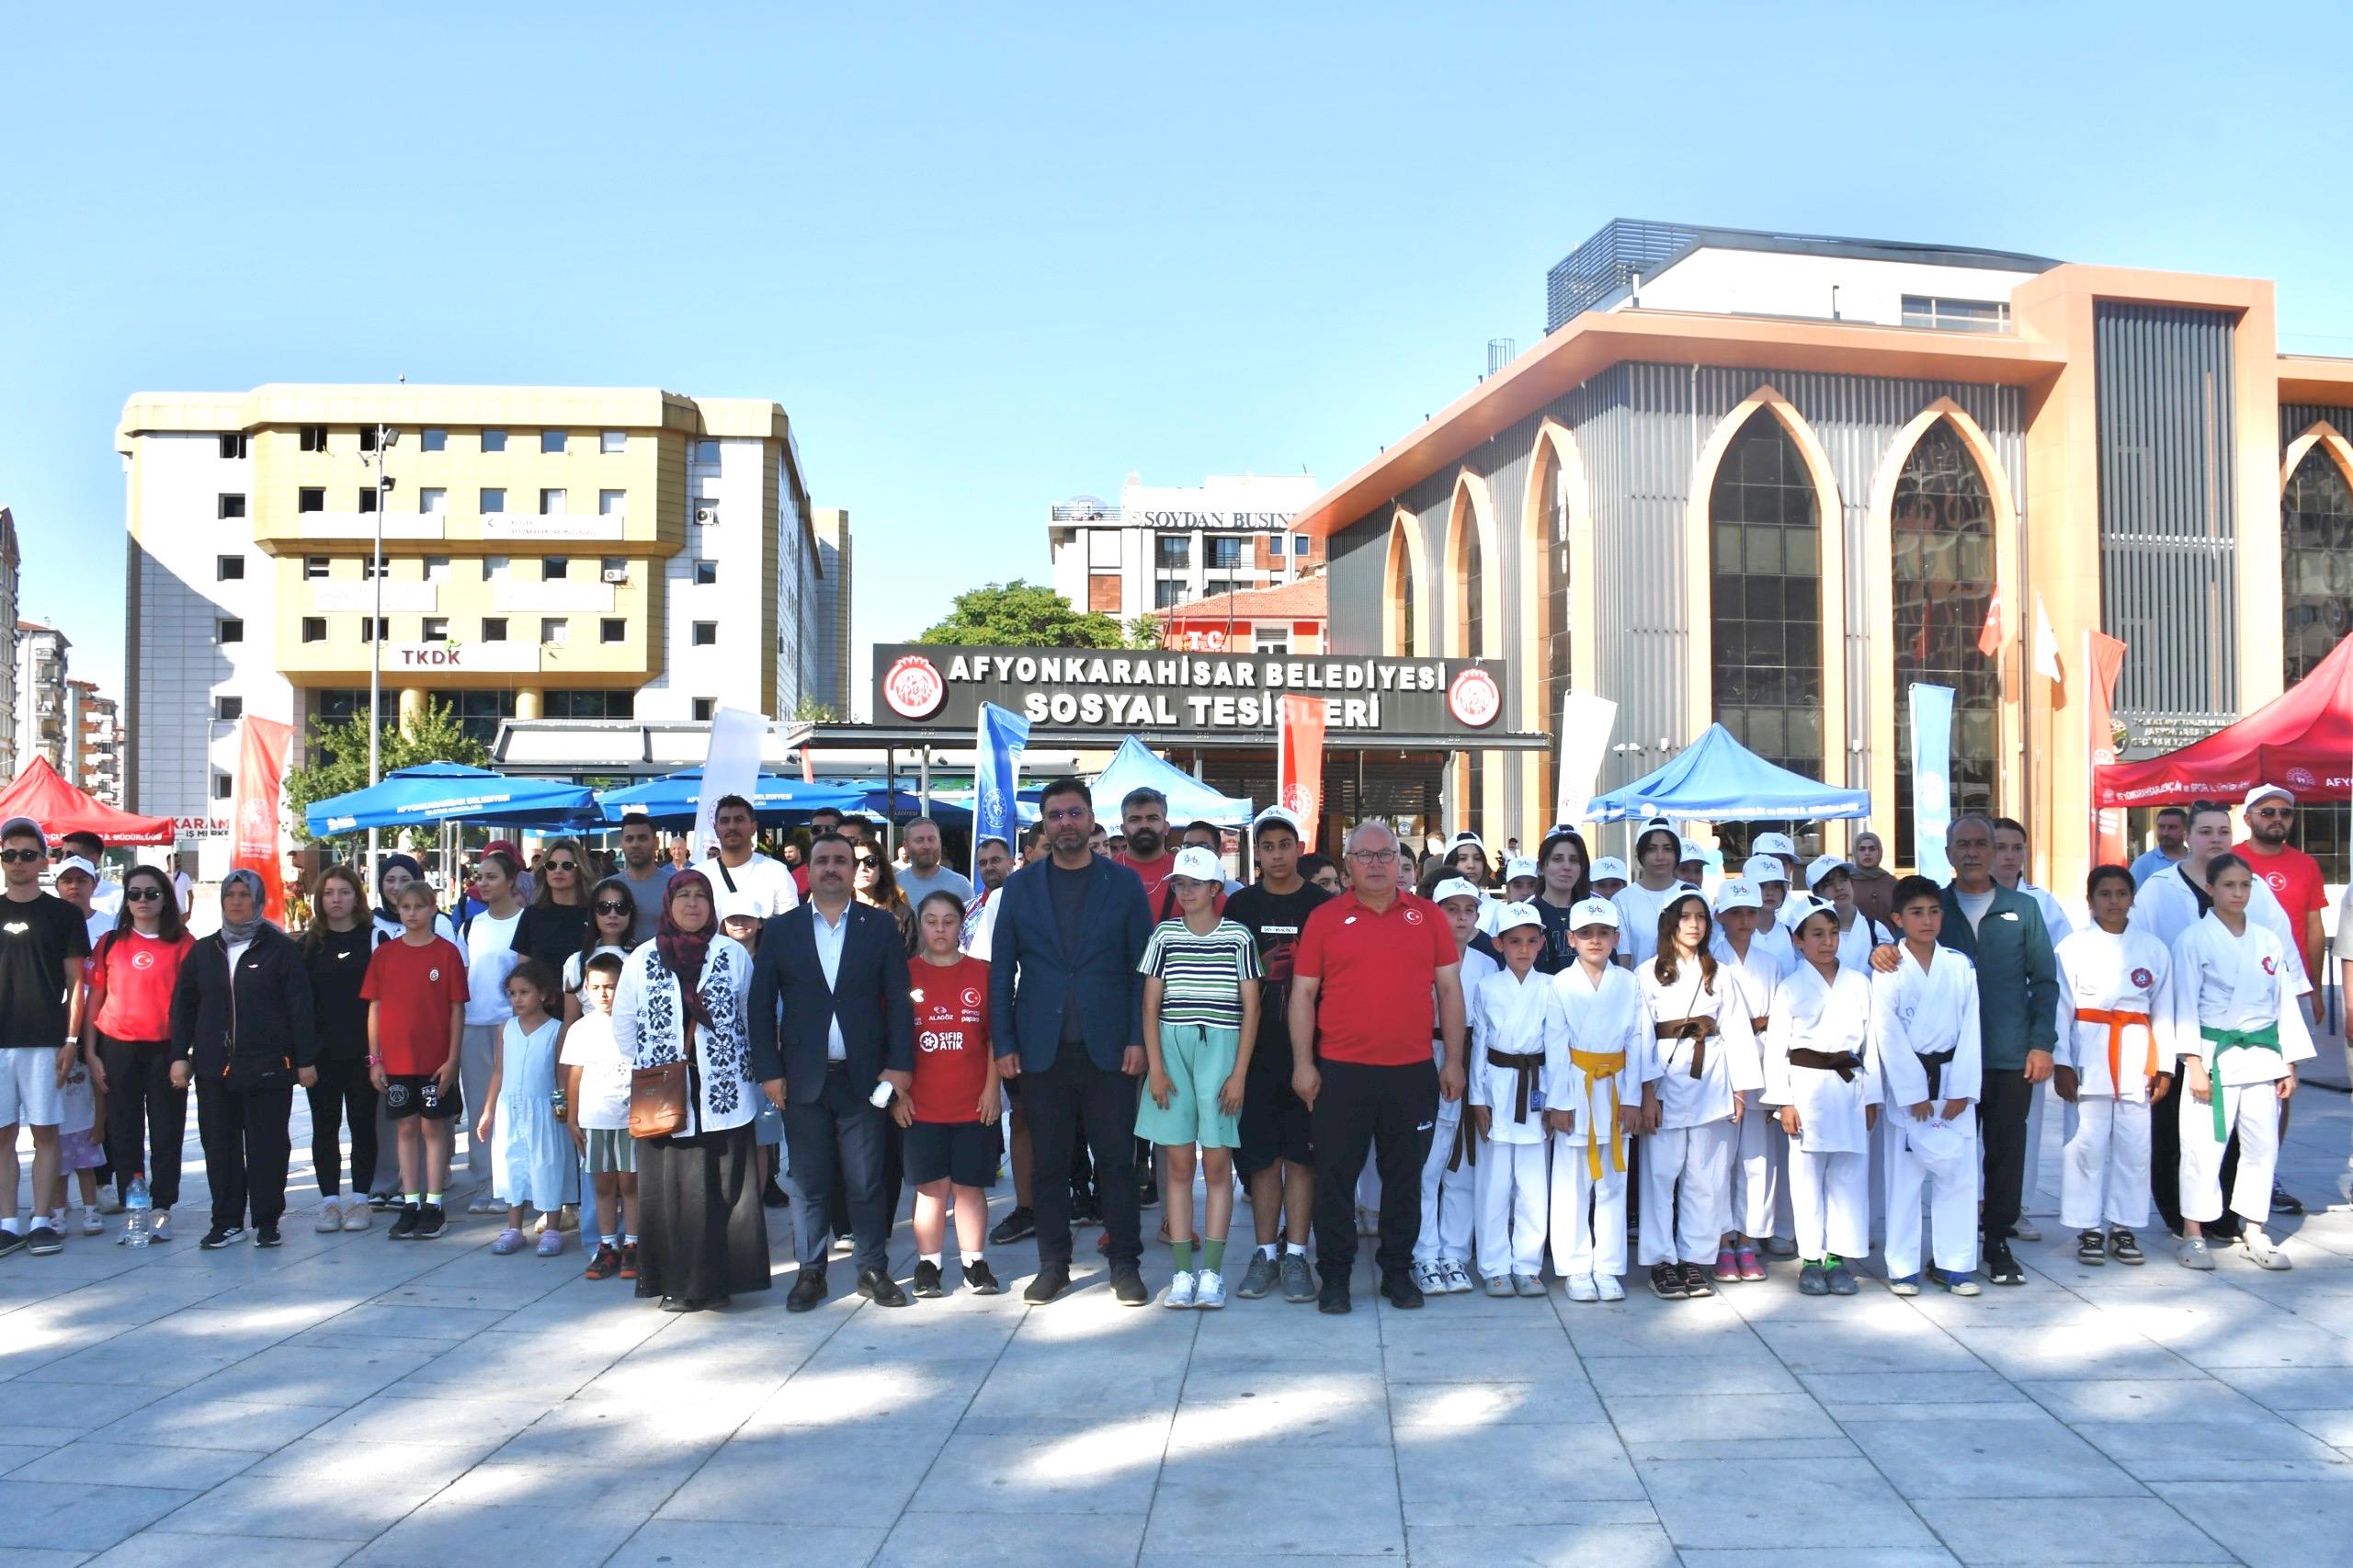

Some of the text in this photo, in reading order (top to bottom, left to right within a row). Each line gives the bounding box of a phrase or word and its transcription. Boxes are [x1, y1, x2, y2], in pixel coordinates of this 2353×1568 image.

[1144, 511, 1297, 528] SOYDAN BUSIN
[1188, 631, 1226, 651] T.C.
[402, 650, 460, 665] TKDK
[949, 655, 1446, 690] AFYONKARAHİSAR BELEDİYESİ
[1025, 692, 1176, 725] SOSYAL
[939, 1031, 963, 1040] SIFIR
[939, 1040, 963, 1051] ATIK
[426, 1096, 438, 1108] 23
